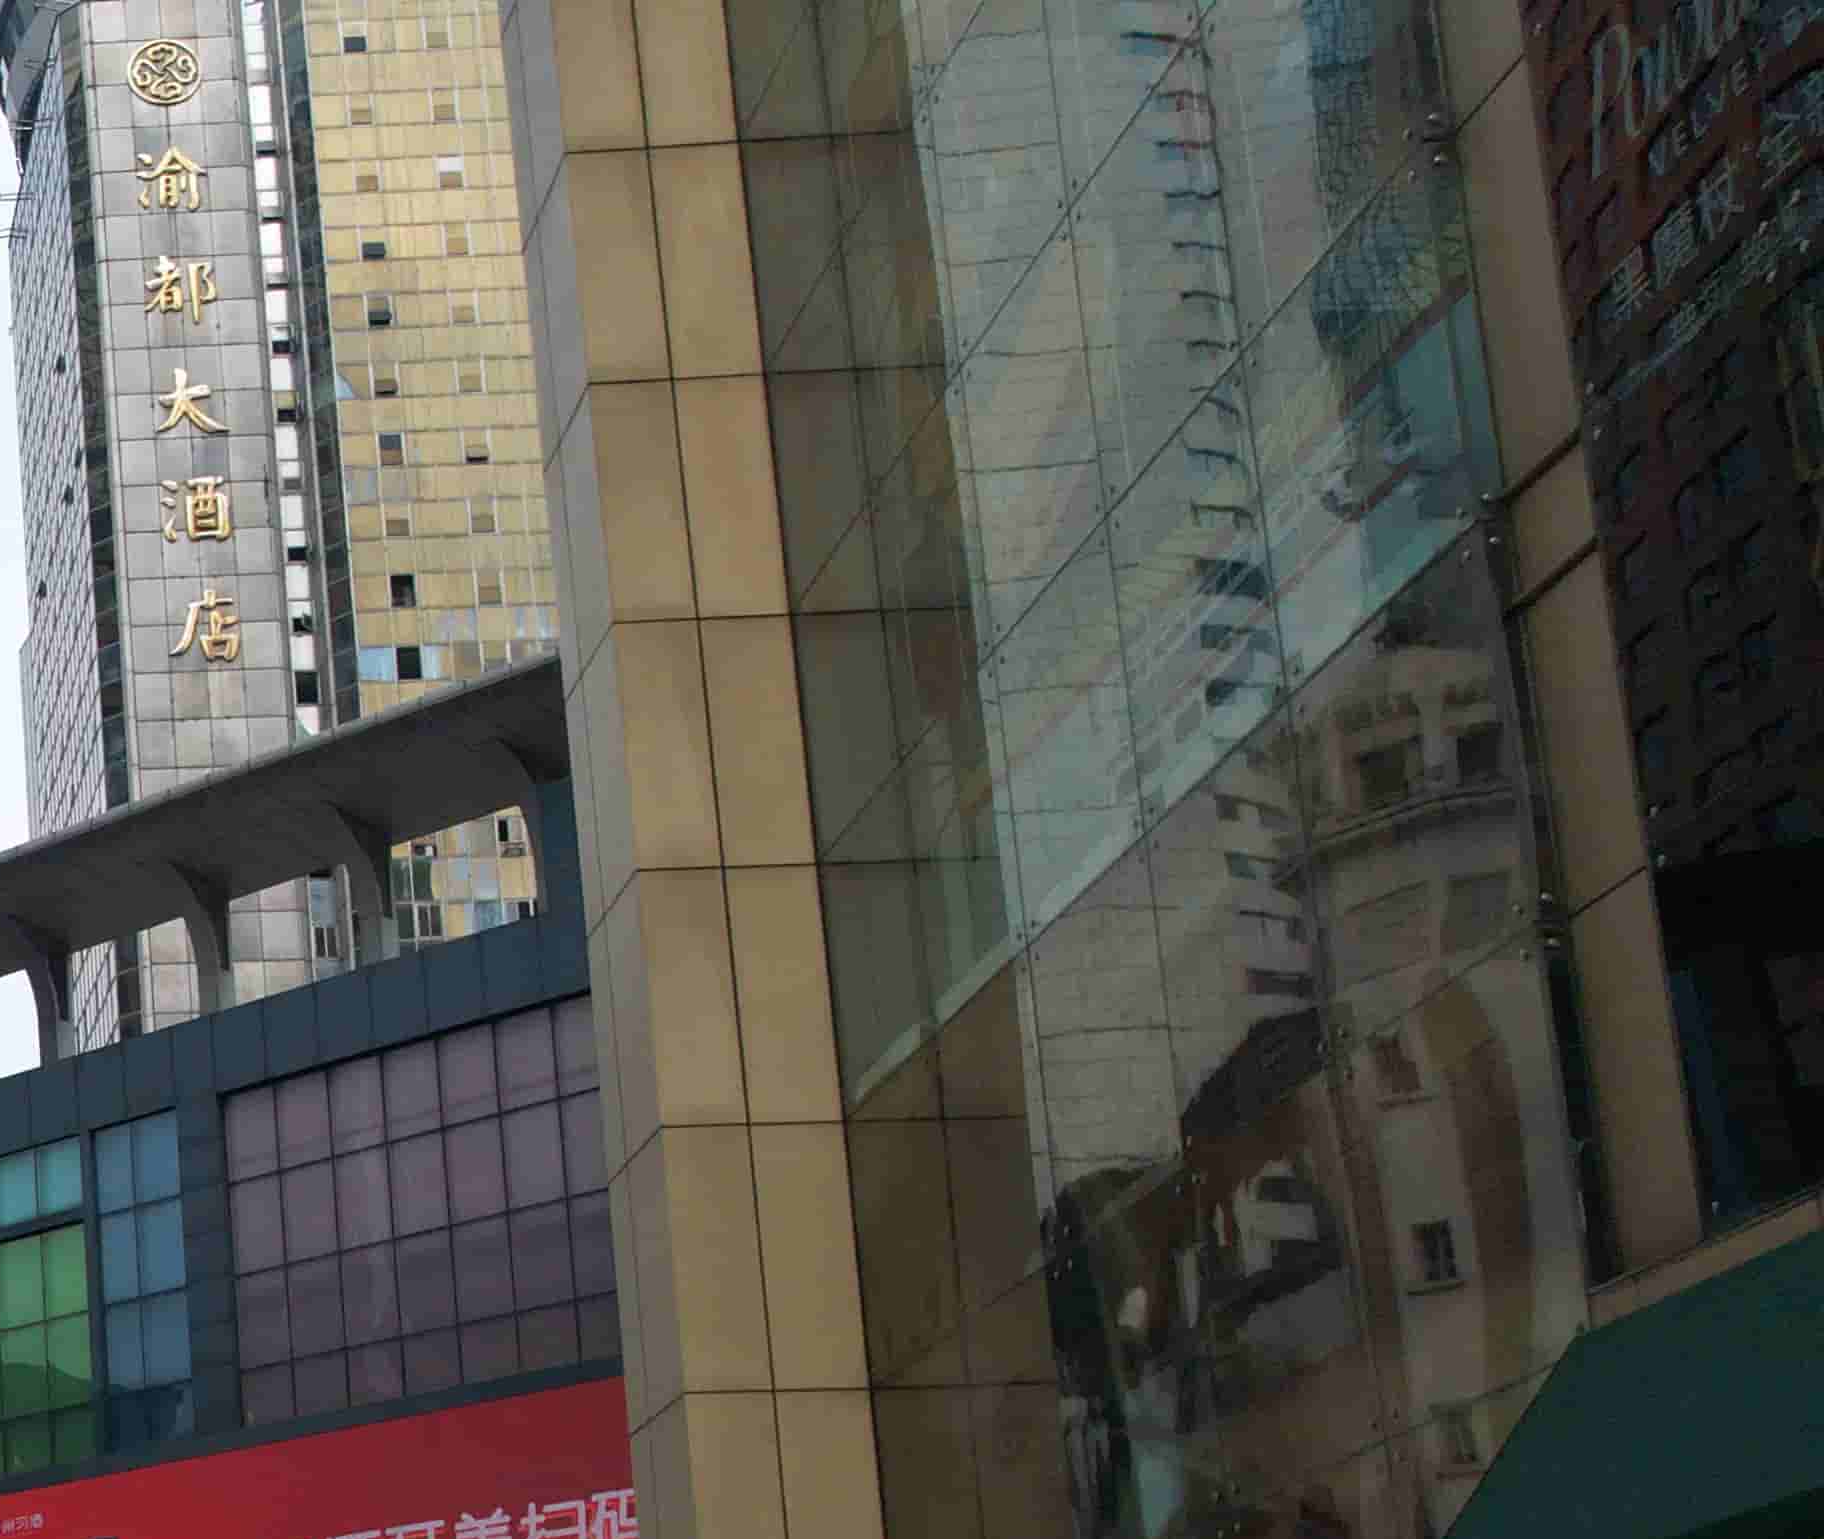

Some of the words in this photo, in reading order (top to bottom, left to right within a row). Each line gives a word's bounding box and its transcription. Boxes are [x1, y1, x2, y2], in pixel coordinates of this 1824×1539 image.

[137, 146, 239, 662] 渝都大酒店
